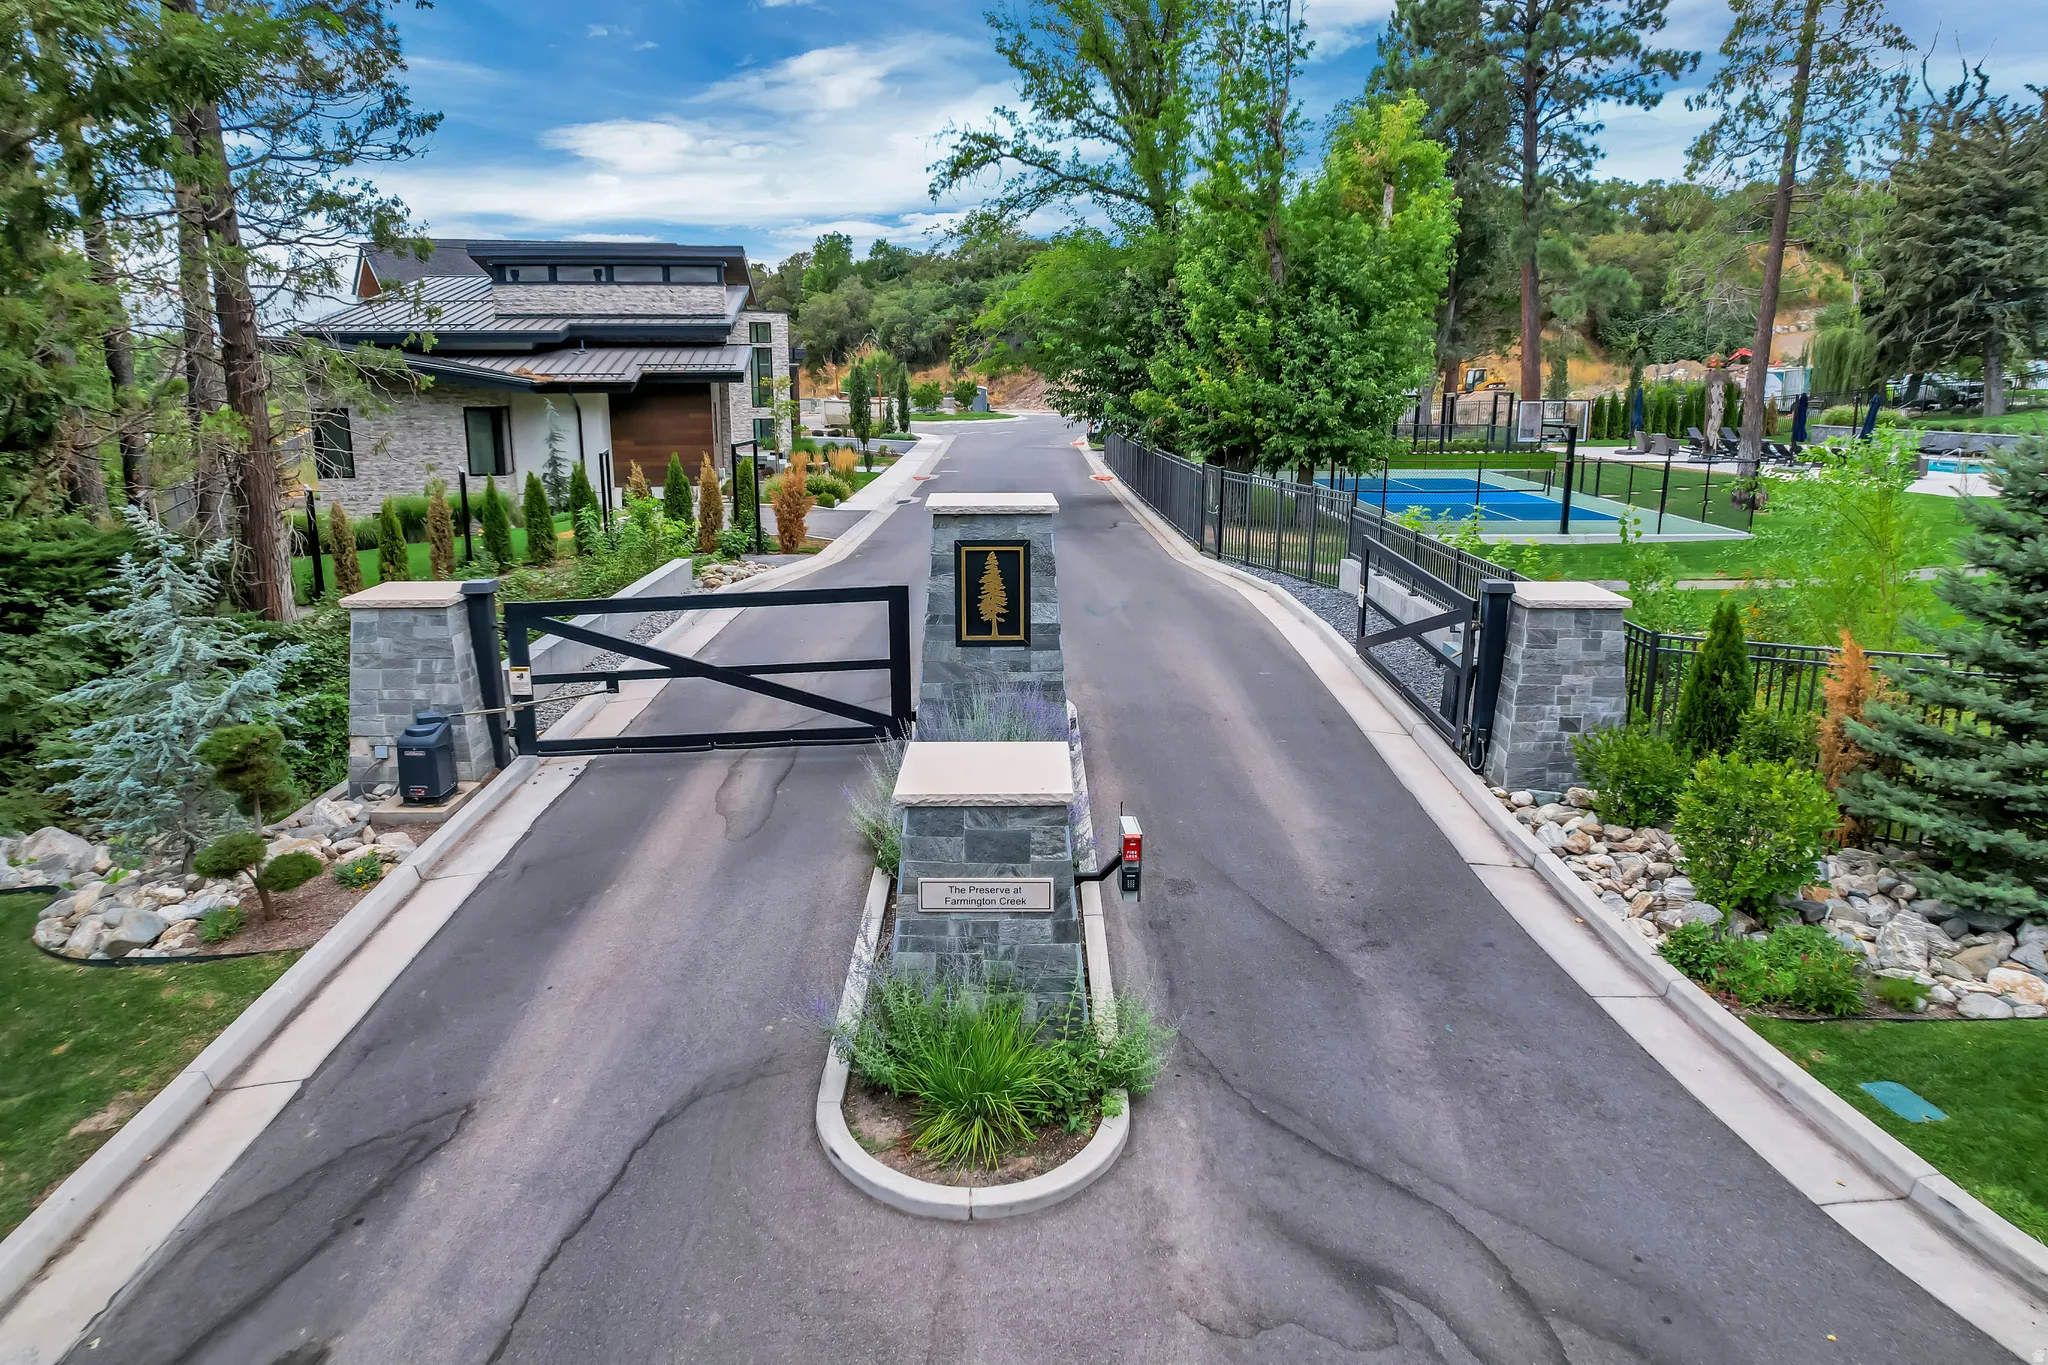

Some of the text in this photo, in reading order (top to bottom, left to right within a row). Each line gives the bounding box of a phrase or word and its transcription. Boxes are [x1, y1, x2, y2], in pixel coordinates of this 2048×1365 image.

[949, 885, 1022, 894] The Preserve at
[944, 897, 1027, 907] Farmington Creek
